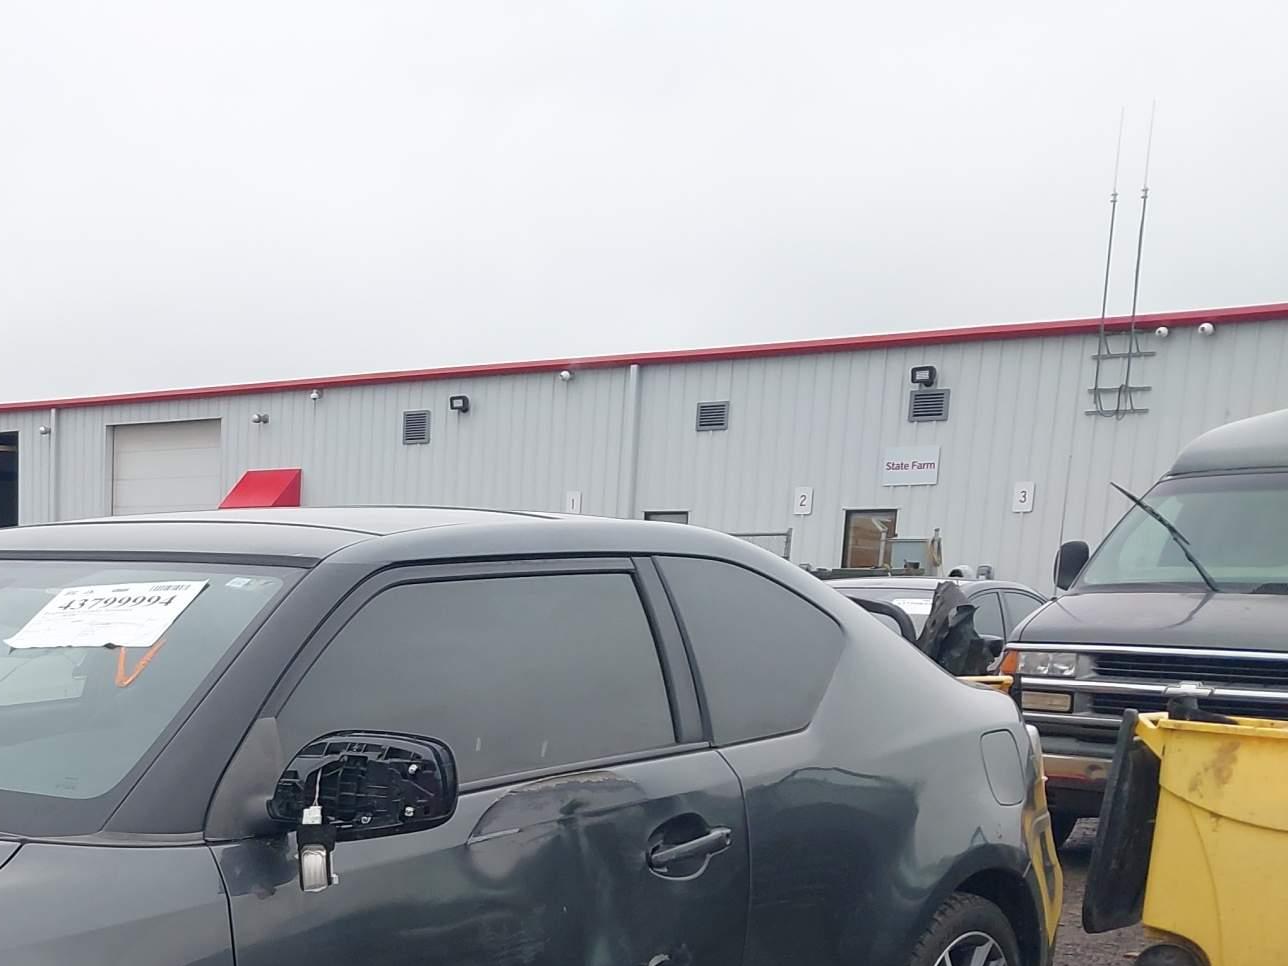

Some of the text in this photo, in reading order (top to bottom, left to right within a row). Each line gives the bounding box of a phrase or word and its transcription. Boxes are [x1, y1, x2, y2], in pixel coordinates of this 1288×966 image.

[885, 461, 936, 471] State Farm
[799, 494, 807, 507] 2
[1019, 490, 1027, 503] 3
[59, 594, 177, 610] 43799994
